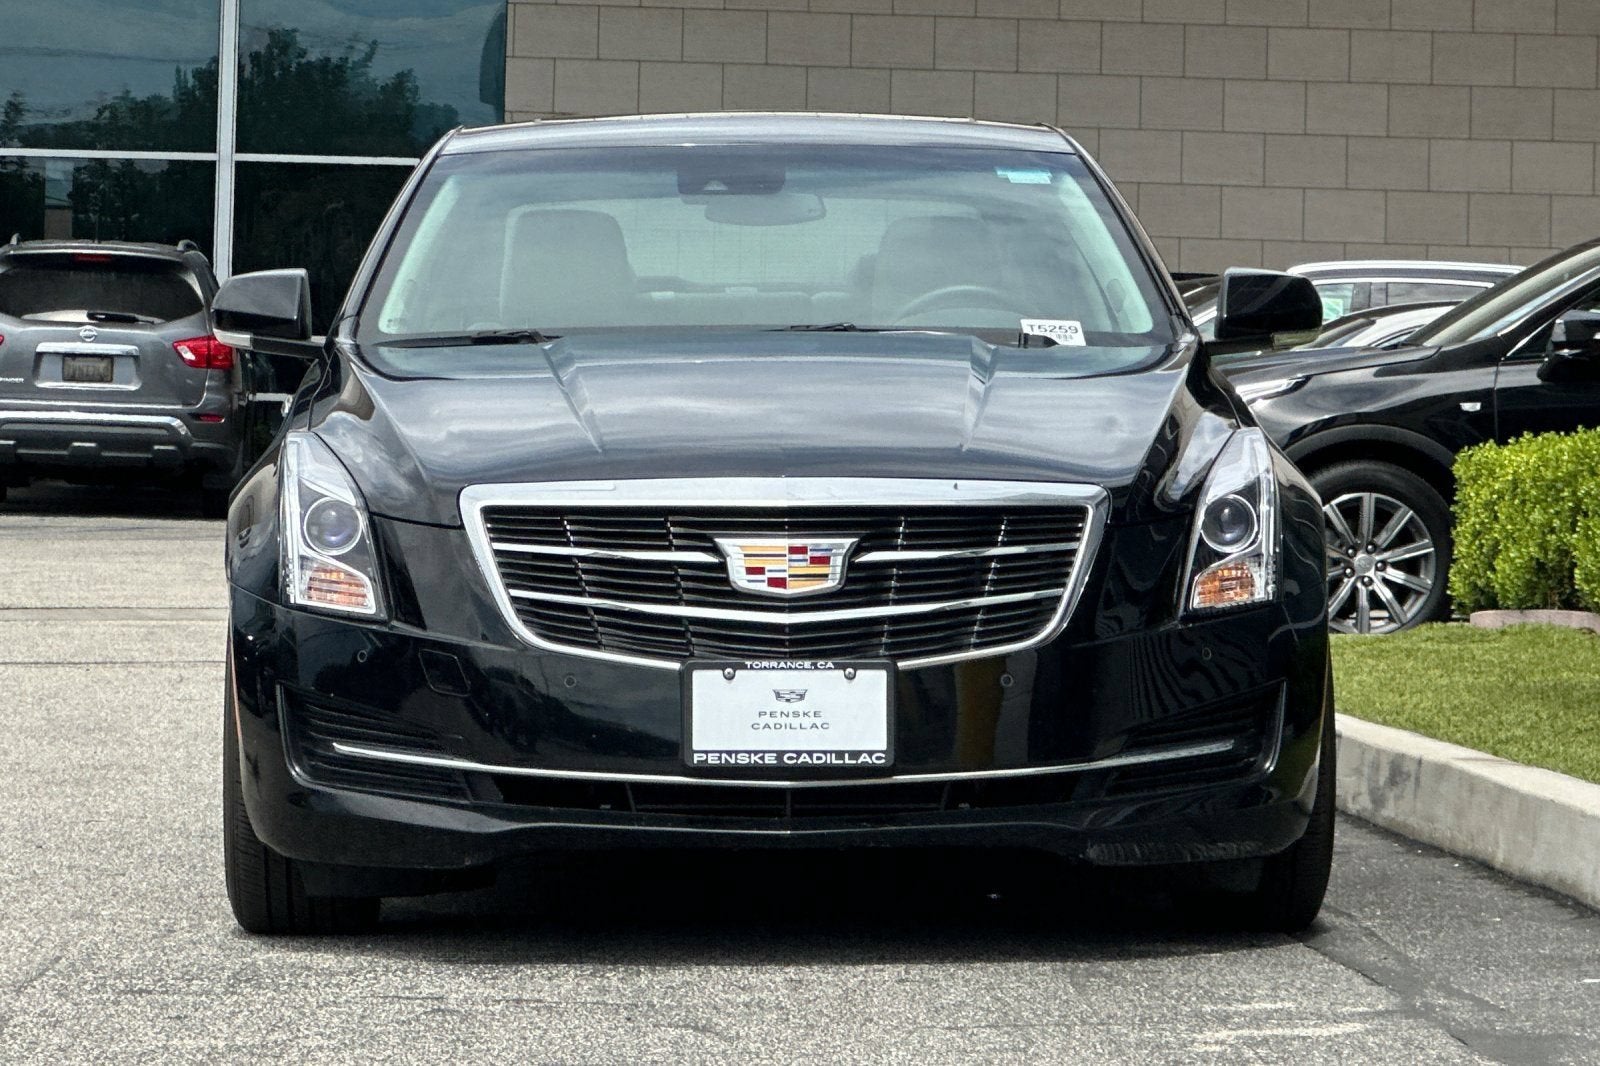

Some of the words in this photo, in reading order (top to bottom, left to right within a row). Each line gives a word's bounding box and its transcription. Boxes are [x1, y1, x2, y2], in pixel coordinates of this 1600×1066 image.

[1026, 324, 1079, 334] T5259
[745, 661, 815, 670] TORRANCE,
[817, 661, 835, 669] CA
[751, 722, 830, 730] CADILLAC
[693, 753, 778, 764] PENSKE
[783, 753, 886, 764] CADILLAC
